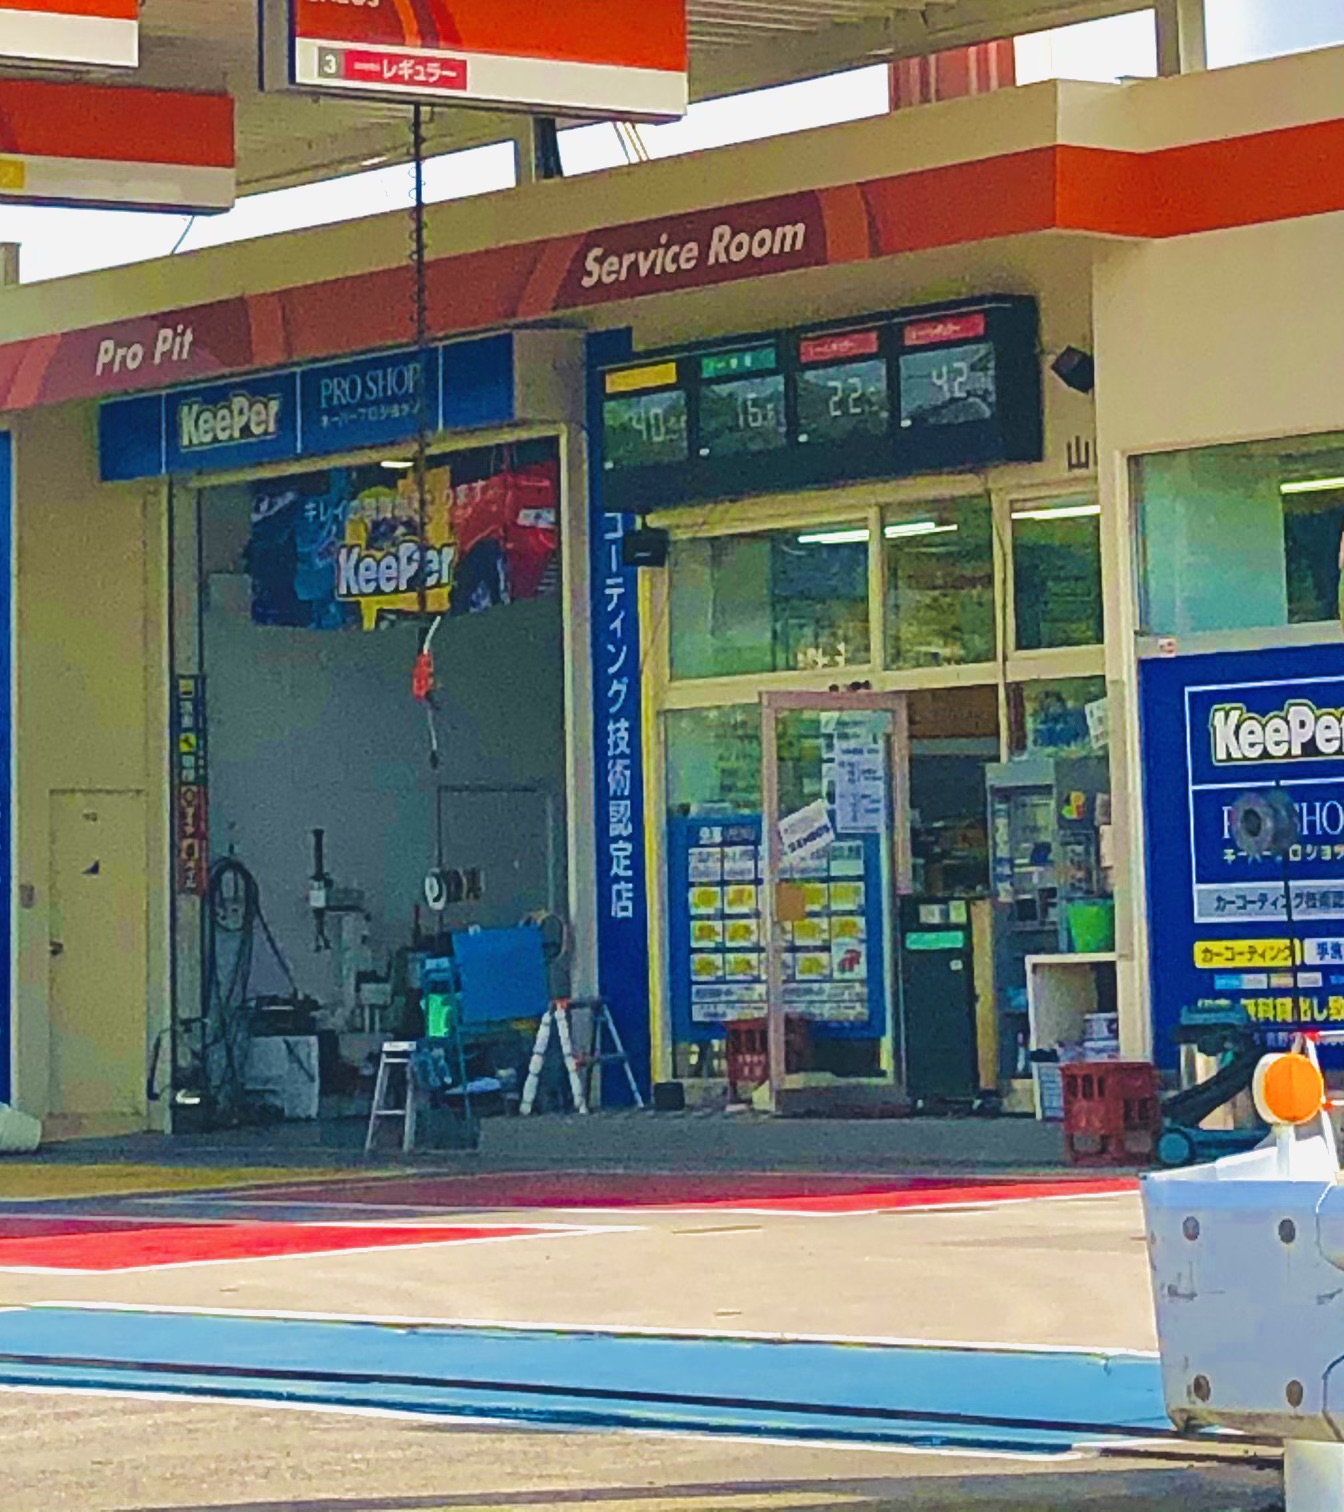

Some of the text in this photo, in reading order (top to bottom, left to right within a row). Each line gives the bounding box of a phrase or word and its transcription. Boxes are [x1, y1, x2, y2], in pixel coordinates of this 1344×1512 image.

[323, 54, 337, 74] 3
[383, 59, 457, 83] レギュラー
[581, 219, 806, 289] Service Room
[96, 323, 193, 377] Pro Pit
[320, 362, 421, 409] PRO SHOP
[179, 392, 280, 450] KeePer
[338, 541, 457, 596] KeePer
